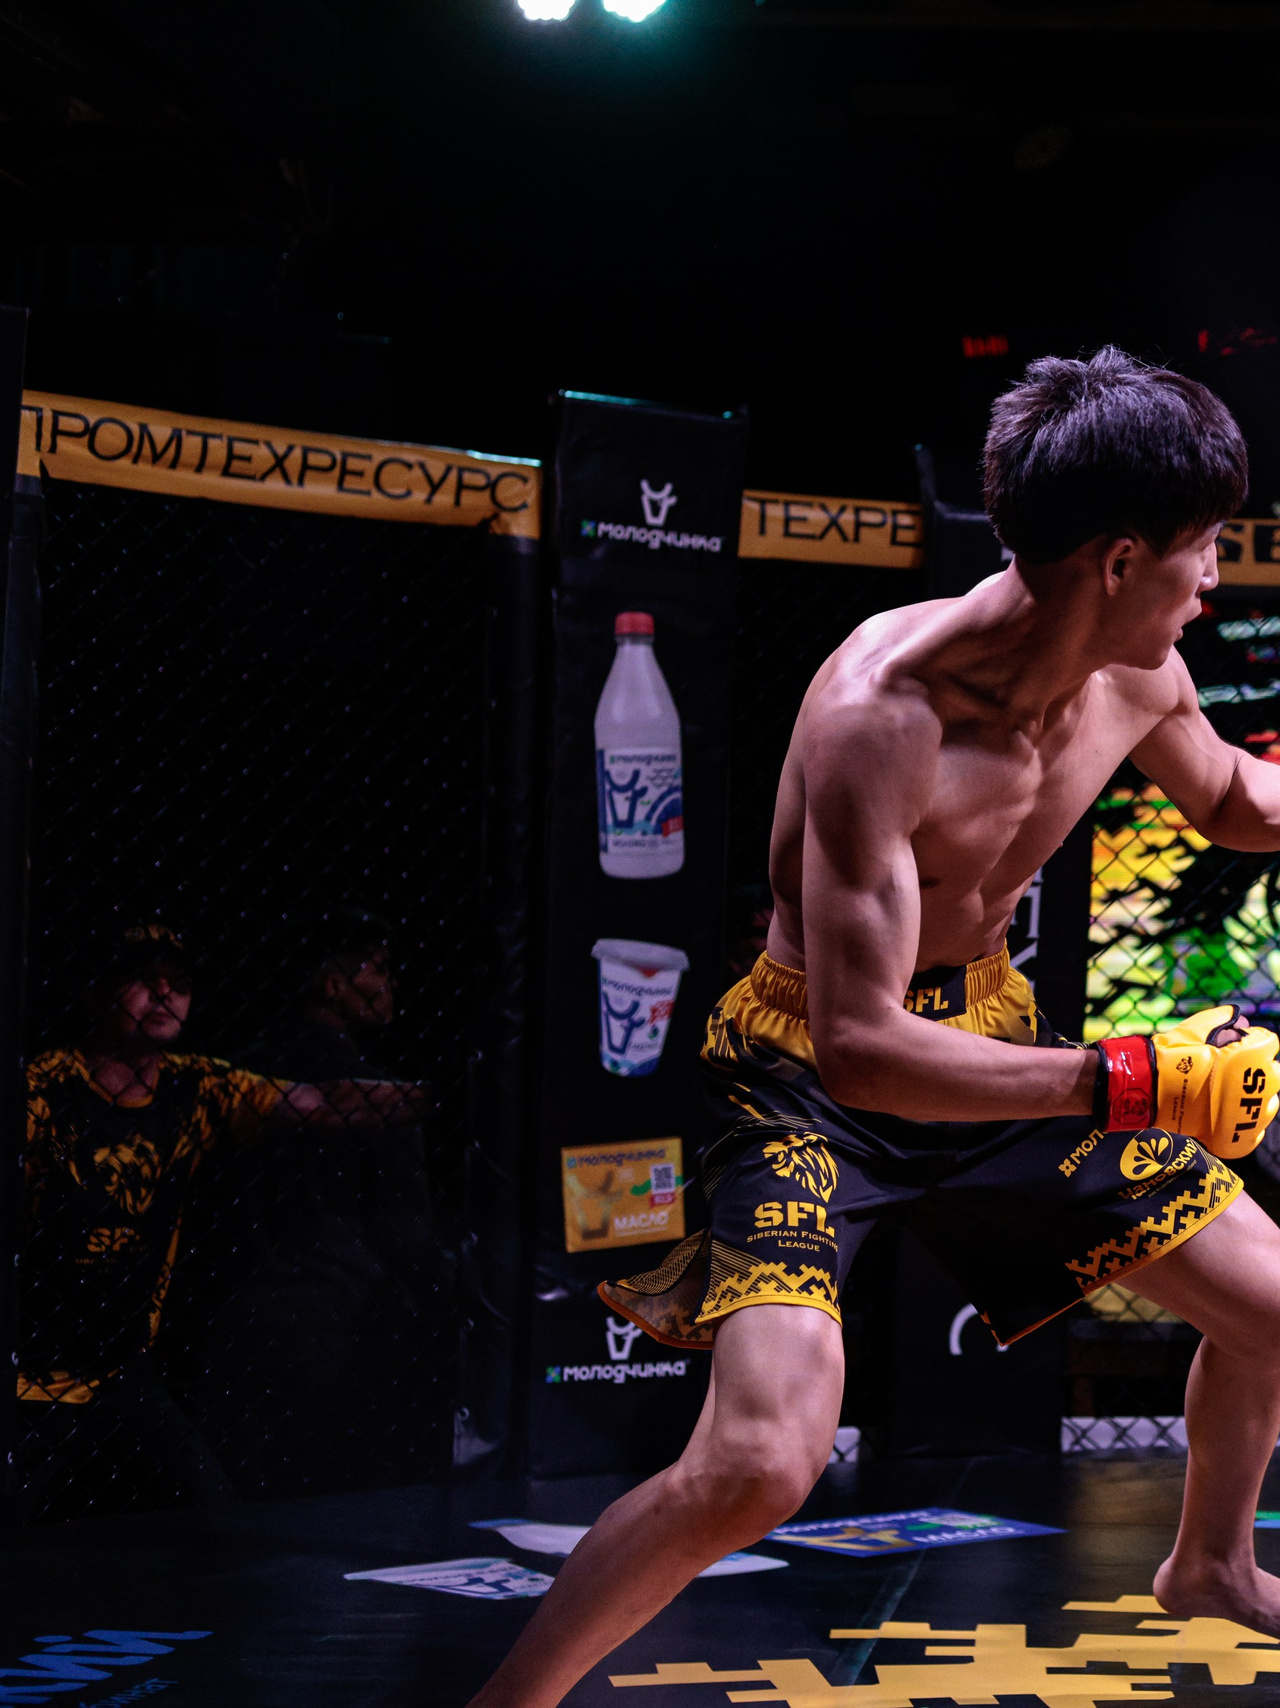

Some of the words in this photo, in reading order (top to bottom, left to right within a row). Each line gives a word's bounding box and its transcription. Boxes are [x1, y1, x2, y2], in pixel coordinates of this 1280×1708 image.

[20, 405, 529, 512] ПРОМТЕХРЕСУРС
[747, 497, 923, 547] ТЕХРЕ
[1231, 1067, 1266, 1143] SFL
[754, 1201, 836, 1238] SFL
